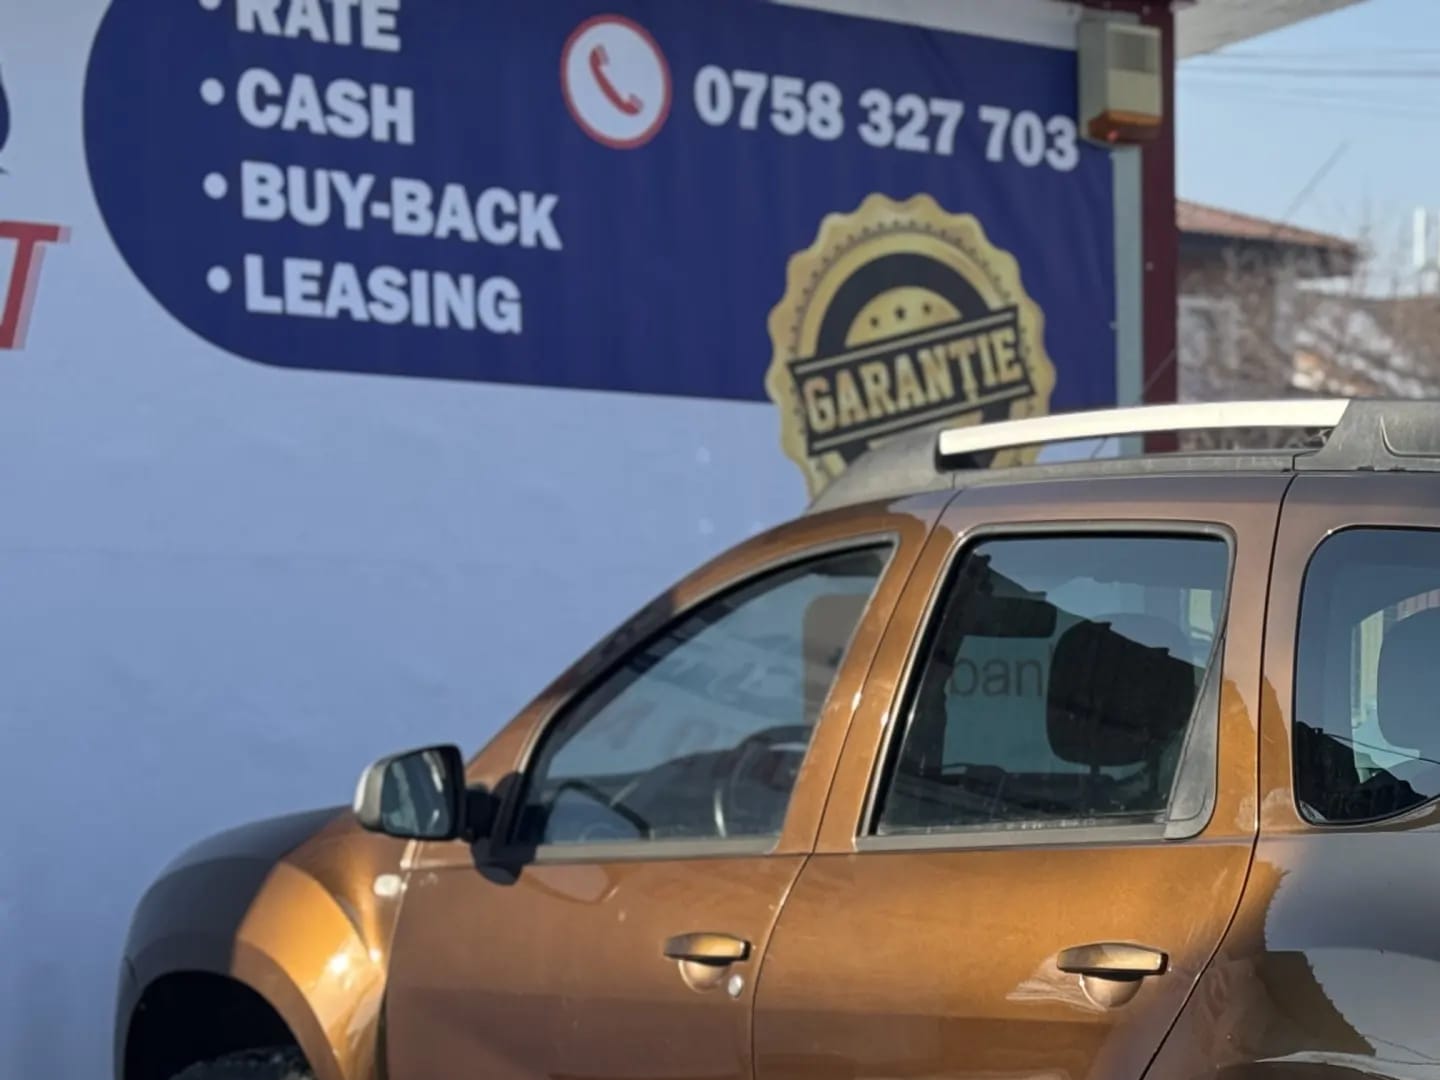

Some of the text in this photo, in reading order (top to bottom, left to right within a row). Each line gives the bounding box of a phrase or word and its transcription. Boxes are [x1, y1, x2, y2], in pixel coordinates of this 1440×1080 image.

[236, 0, 401, 51] RATE
[236, 67, 415, 145] CASH
[694, 65, 1079, 171] 0758 327 703
[240, 160, 563, 250] BUY-BACK
[244, 254, 522, 334] LEASING
